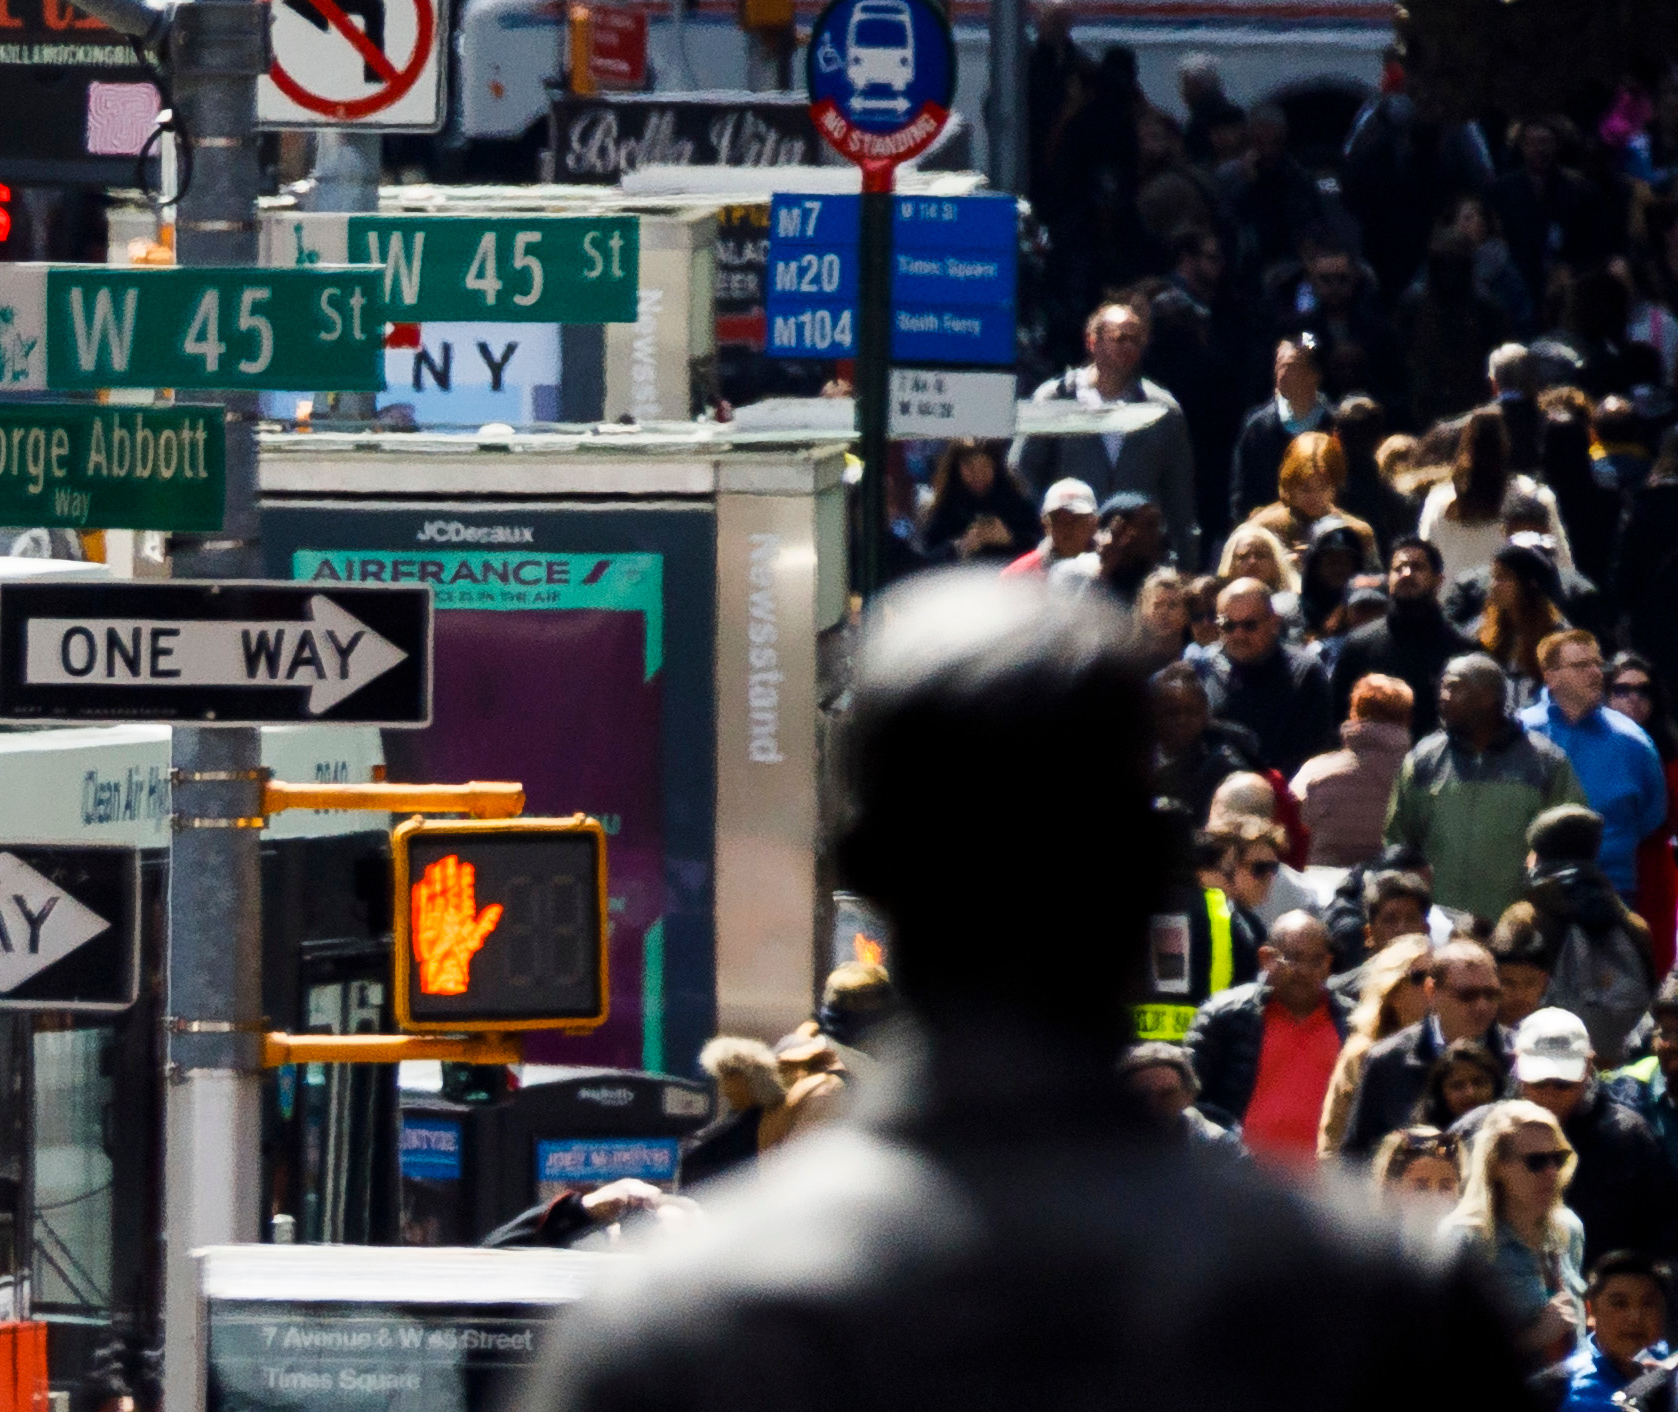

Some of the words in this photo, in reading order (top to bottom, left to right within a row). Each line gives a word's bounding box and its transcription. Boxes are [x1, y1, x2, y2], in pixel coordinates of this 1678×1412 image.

[821, 107, 848, 141] NO
[777, 201, 823, 238] M7
[367, 231, 426, 306] W
[464, 230, 547, 307] 45
[582, 230, 627, 281] St
[774, 253, 841, 293] M20
[68, 285, 140, 373] W
[184, 286, 274, 376] 45
[318, 285, 369, 344] St
[772, 309, 853, 350] M104
[88, 416, 211, 481] Abbott
[54, 487, 92, 525] Way
[60, 626, 181, 678] ONE
[241, 629, 368, 681] WAY
[746, 530, 784, 767] Newsstand
[262, 1328, 275, 1349] 7
[282, 1328, 374, 1350] Avenue
[376, 1328, 395, 1349] &
[398, 1328, 426, 1349] W
[462, 1328, 534, 1351] Street
[265, 1367, 334, 1389] Times
[338, 1367, 422, 1393] Square
